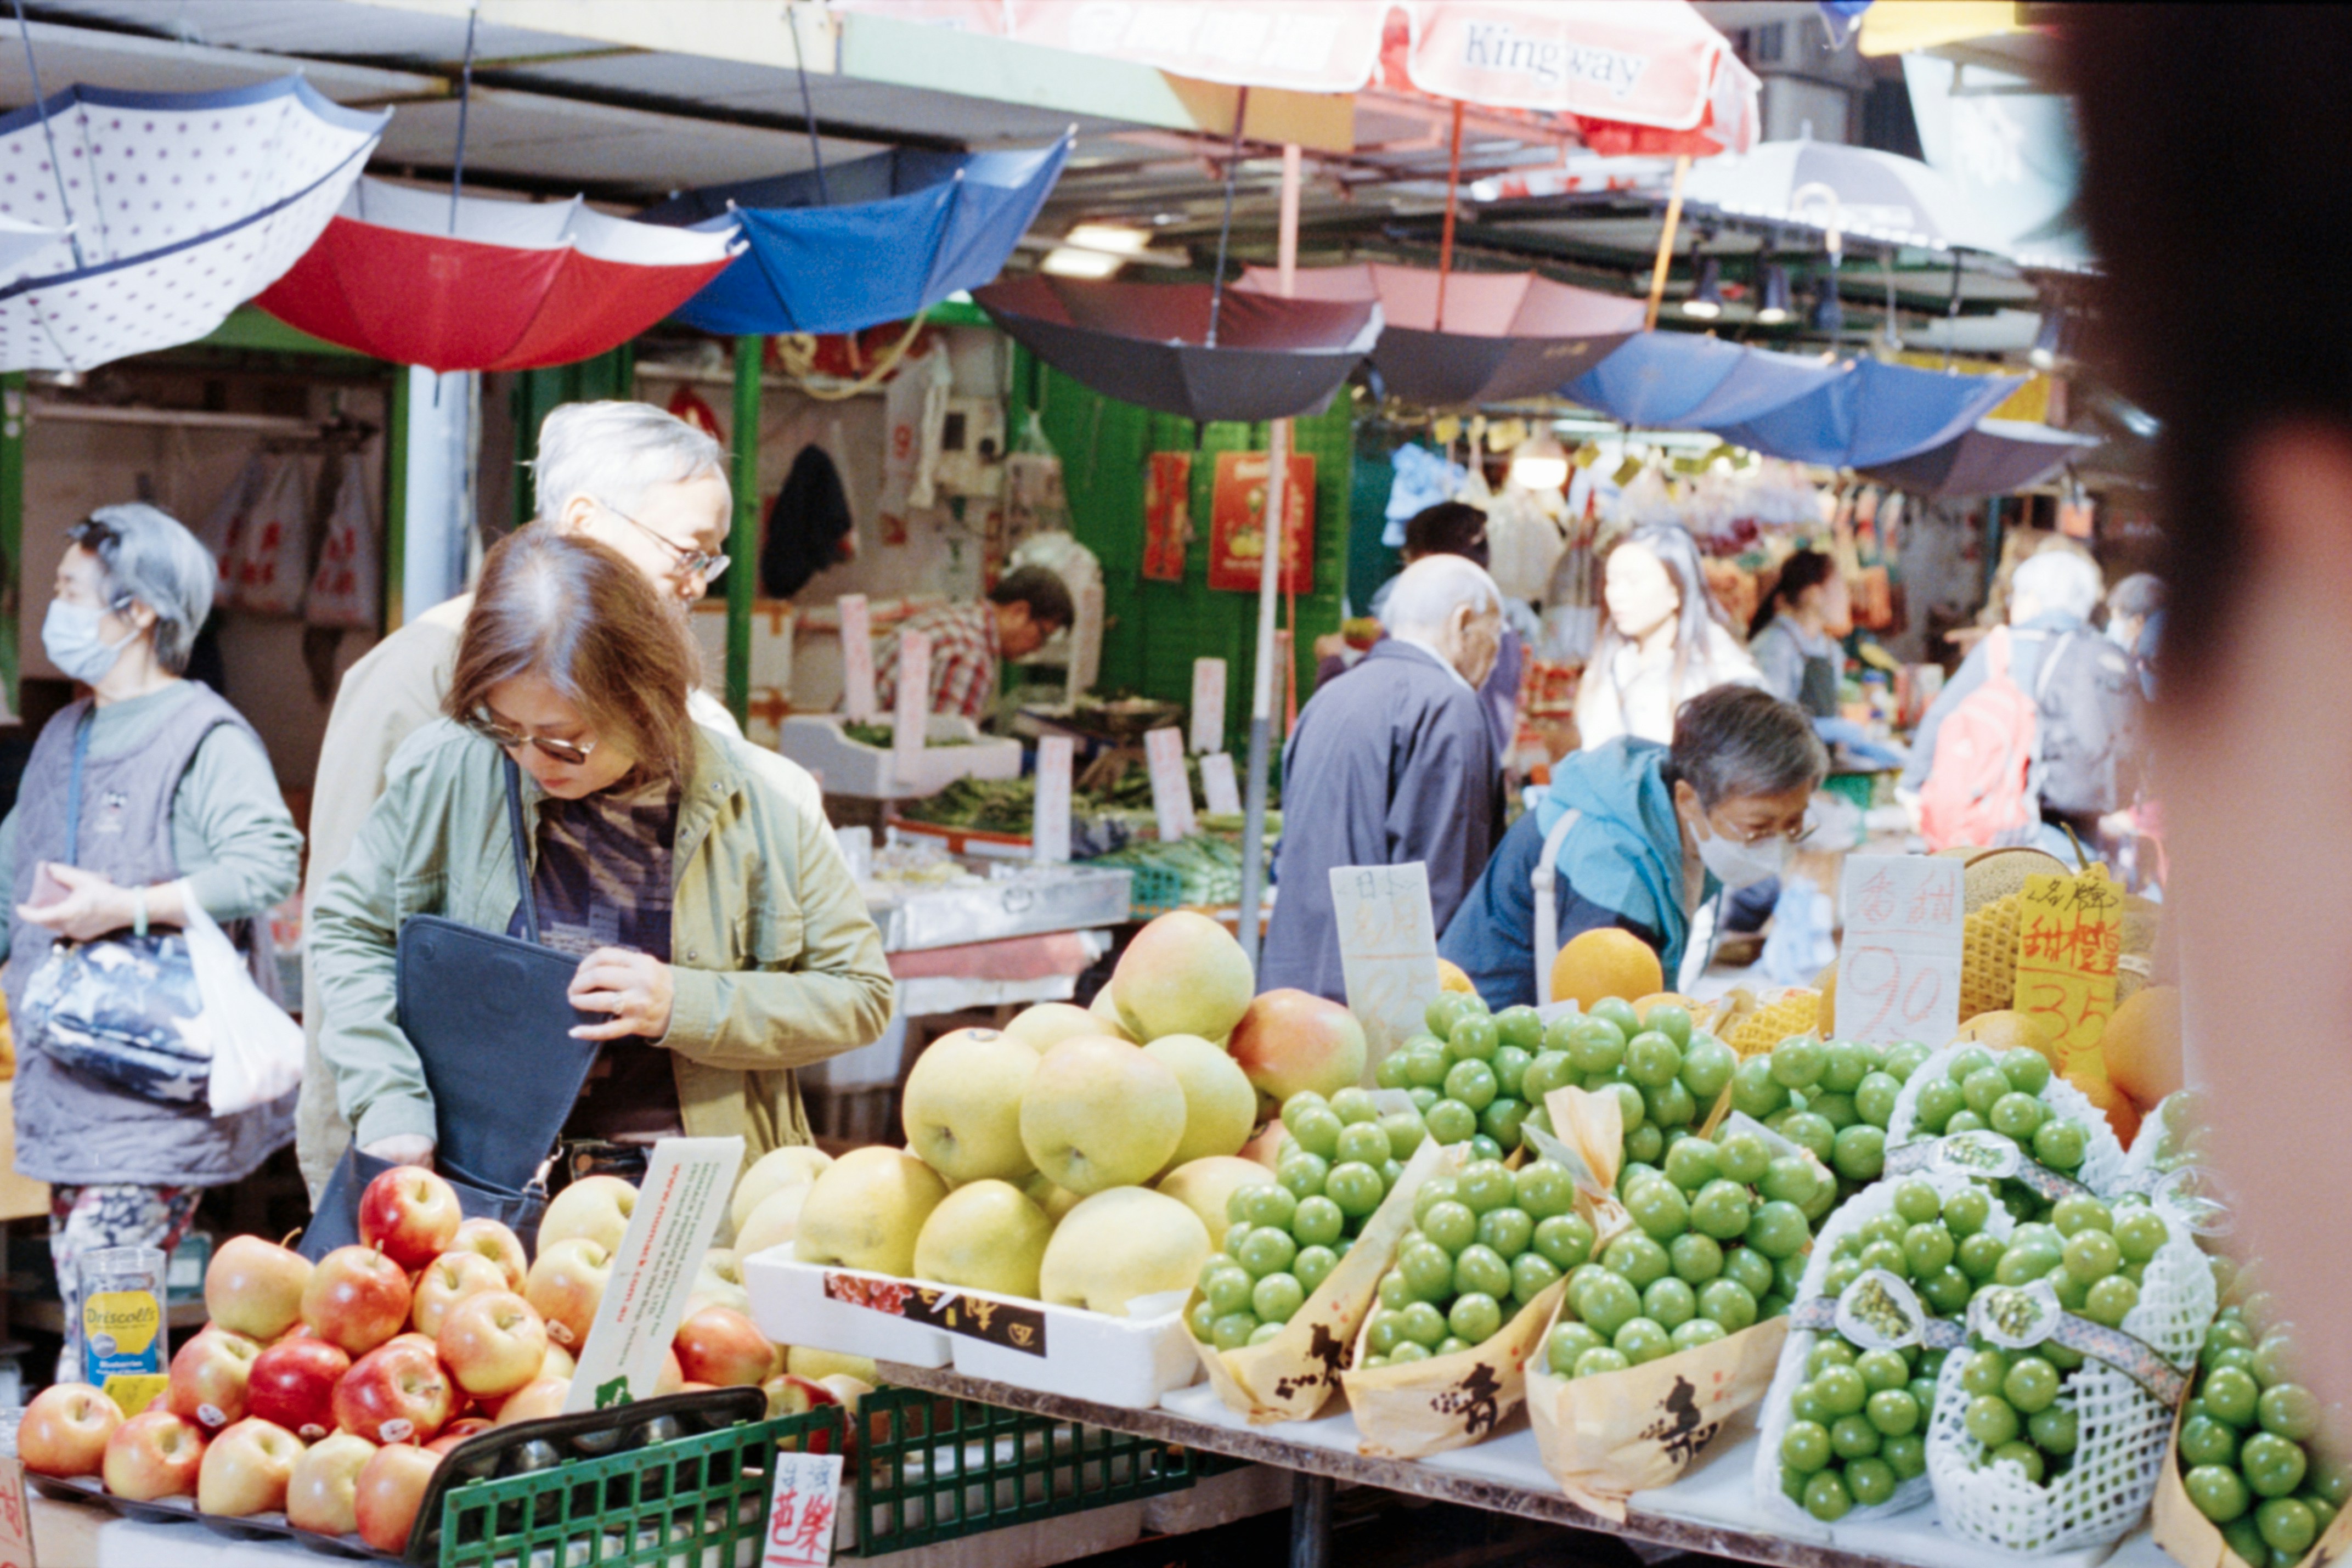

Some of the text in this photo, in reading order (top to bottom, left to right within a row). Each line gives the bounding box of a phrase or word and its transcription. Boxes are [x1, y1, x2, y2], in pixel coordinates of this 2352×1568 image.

[1854, 867, 1956, 925] 香甜
[1847, 946, 1942, 1041] 90
[2030, 984, 2108, 1052] 35
[86, 1307, 155, 1324] Driscoll's
